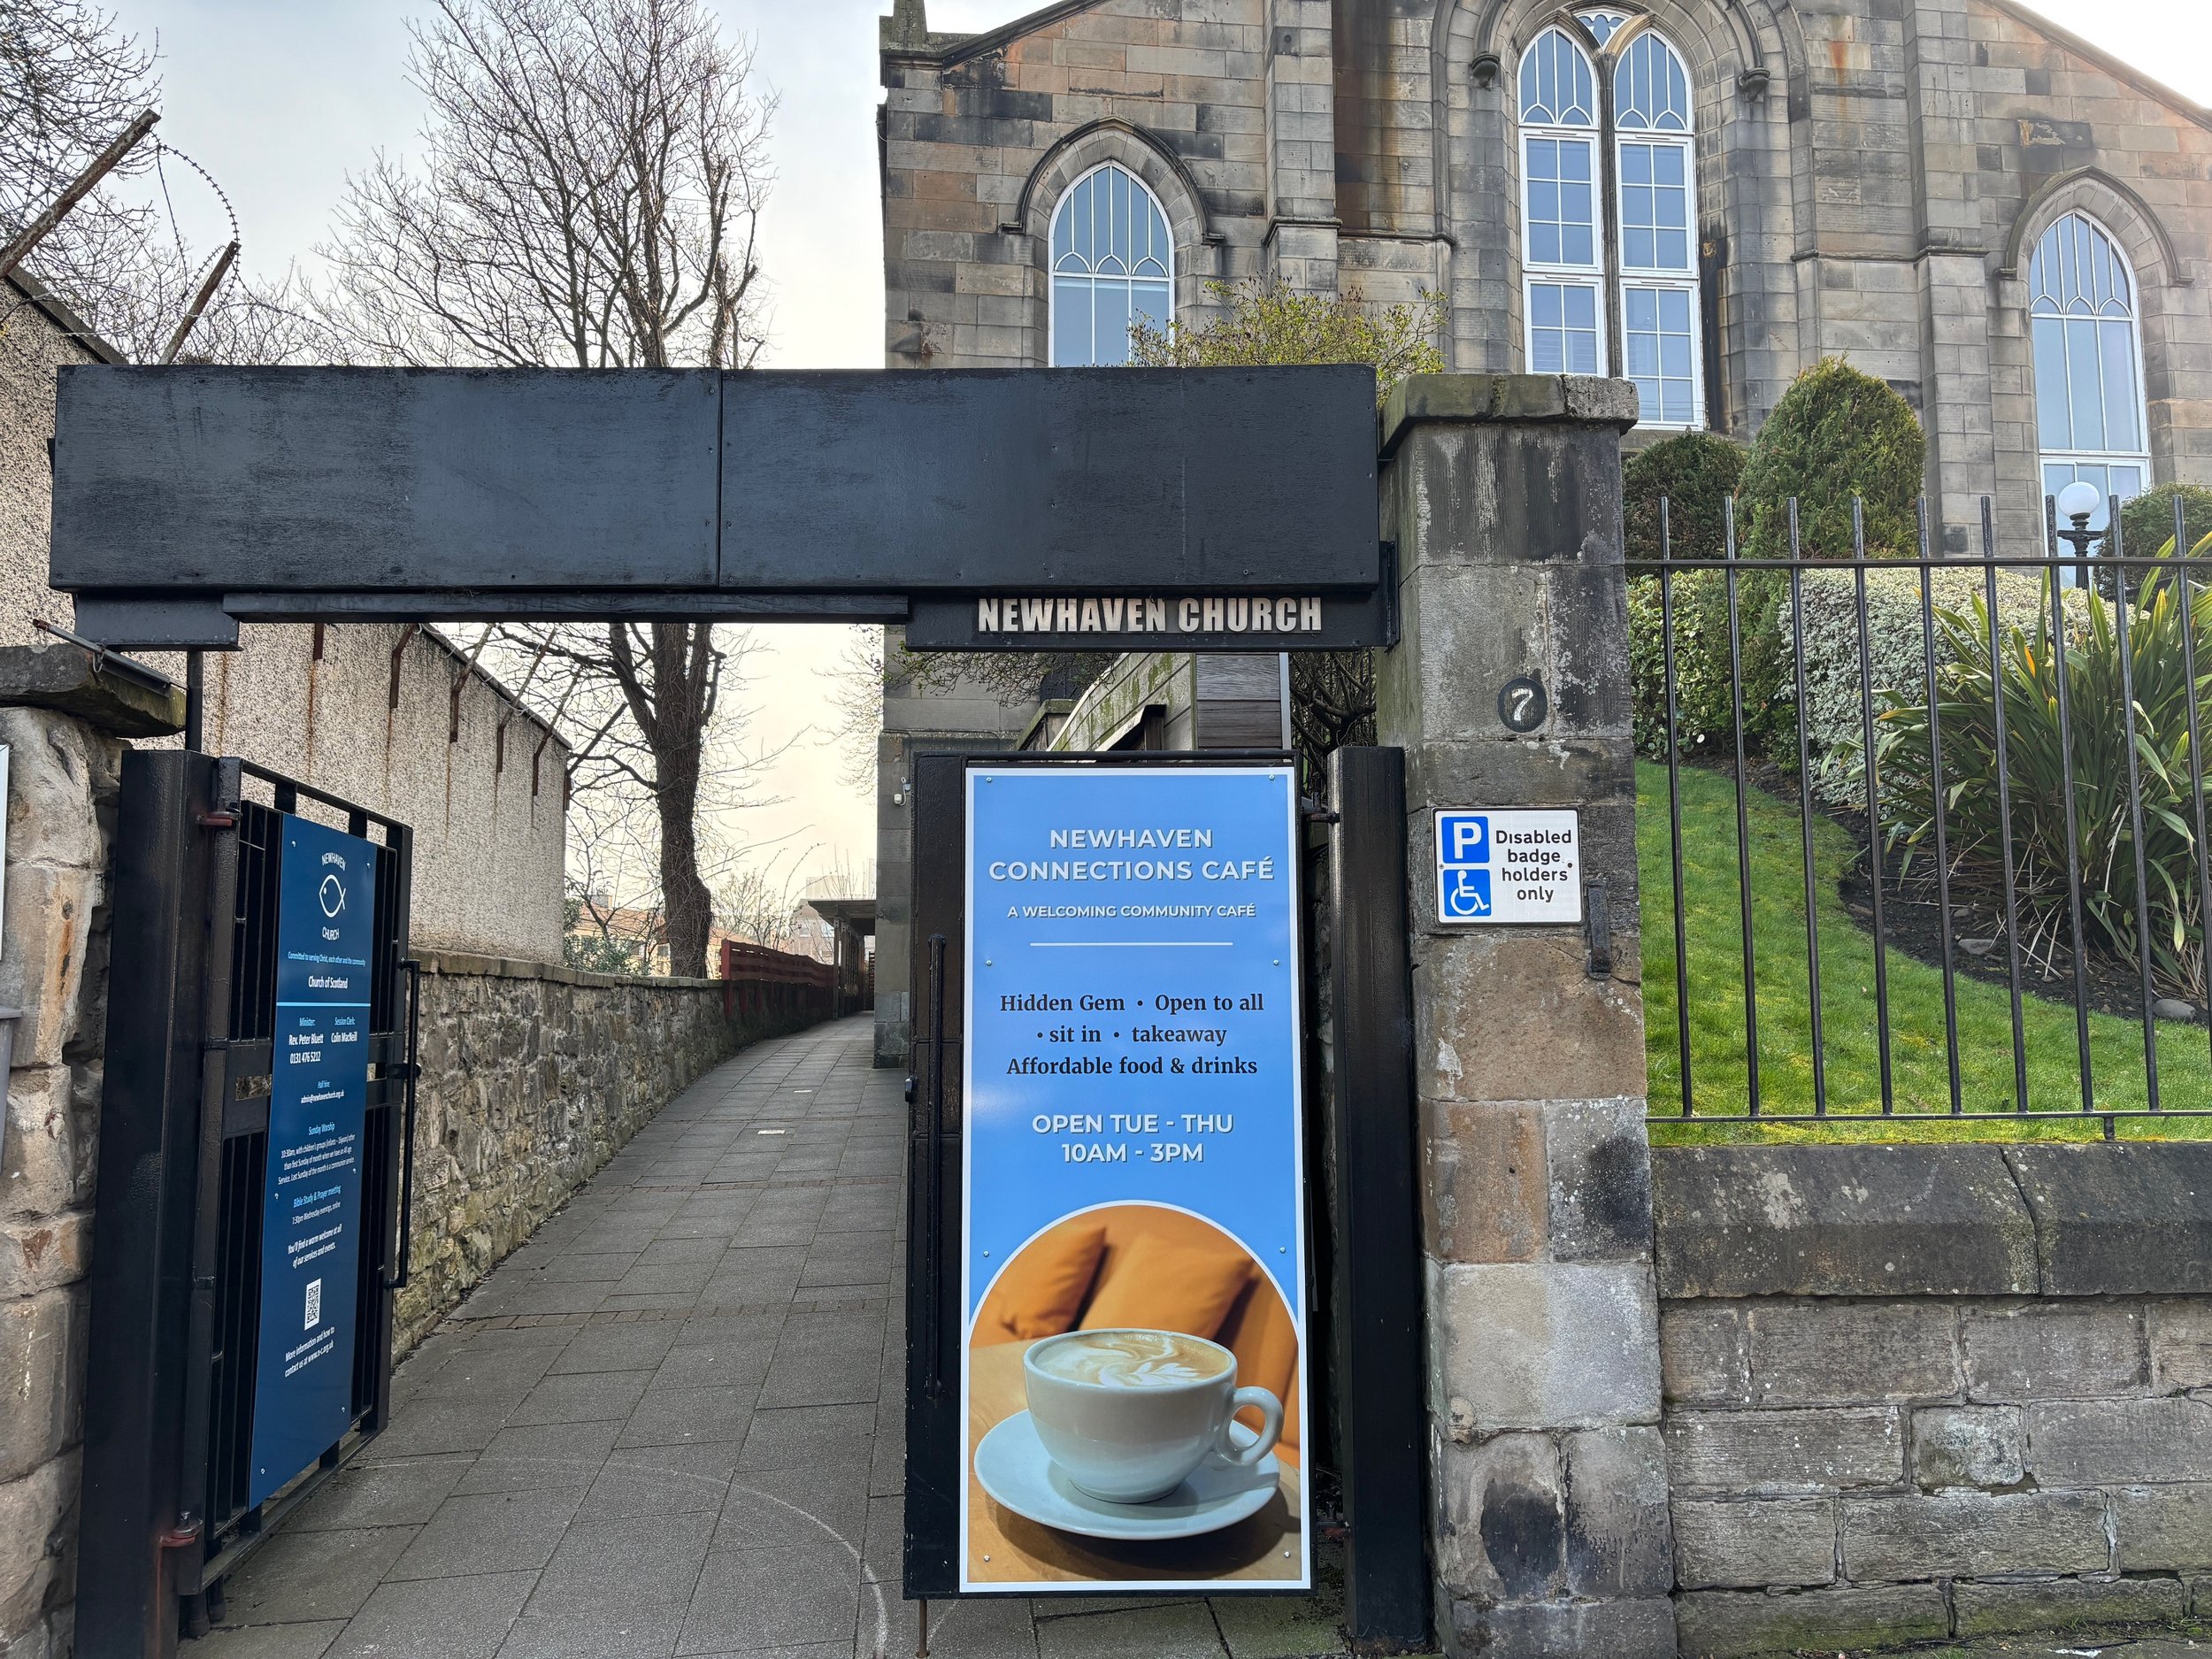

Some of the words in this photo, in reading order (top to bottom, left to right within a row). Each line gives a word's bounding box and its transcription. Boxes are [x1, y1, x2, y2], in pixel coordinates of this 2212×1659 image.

[978, 597, 1166, 633] NEWHAVEN
[1178, 597, 1322, 633] CHURCH
[1511, 687, 1534, 721] 7
[1049, 829, 1213, 849] NEWHAVEN
[1454, 822, 1481, 859] P
[1495, 830, 1572, 844] Disabled
[321, 852, 346, 872] NEWHAVEN
[1508, 848, 1561, 864] badge
[988, 861, 1193, 881] CONNECTIONS
[1202, 856, 1274, 880] CAFÉ
[1502, 867, 1568, 881] holders
[1517, 887, 1554, 902] only
[1007, 906, 1018, 918] A
[1022, 906, 1118, 918] WELCOMING
[1120, 905, 1213, 918] COMMUNITY
[1217, 903, 1256, 917] CAFÉ
[322, 926, 340, 941] CHURCH
[309, 953, 319, 963] serving
[308, 975, 324, 987] Church
[325, 976, 330, 988] of
[330, 977, 348, 989] Scotland
[1000, 994, 1073, 1011] Hidden
[1079, 995, 1125, 1011] Gem
[1155, 995, 1206, 1015] Open
[1214, 996, 1233, 1011] to
[1239, 993, 1263, 1010] all
[299, 1017, 315, 1026] Minister:
[334, 1017, 346, 1025] Session
[288, 1034, 298, 1045] Rev.
[299, 1034, 311, 1045] Peter
[311, 1033, 324, 1044] Bluett
[331, 1032, 341, 1042] Colin
[342, 1031, 357, 1041] MacNeill
[1049, 1025, 1075, 1042] sit
[1081, 1025, 1102, 1042] in
[1132, 1025, 1227, 1046] takeaway
[290, 1053, 301, 1064] 0131
[311, 1051, 320, 1062] 5212
[1007, 1056, 1113, 1075] Affordable
[1118, 1056, 1163, 1075] food
[1170, 1057, 1185, 1074] &
[1191, 1056, 1258, 1074] drinks
[308, 1125, 321, 1135] Sunday
[321, 1121, 335, 1133] Worship
[1032, 1114, 1103, 1134] OPEN
[1110, 1114, 1159, 1133] TUE
[1181, 1114, 1234, 1133] THU
[1061, 1143, 1127, 1163] 10AM
[1150, 1142, 1204, 1163] 3PM
[298, 1157, 309, 1166] Sunday
[297, 1170, 308, 1179] Sunday
[294, 1196, 303, 1208] Bible
[303, 1194, 313, 1204] Study
[318, 1190, 327, 1200] Prayer
[328, 1185, 342, 1195] meeting
[303, 1208, 319, 1220] Wednesday
[288, 1241, 298, 1255] You'll
[297, 1239, 306, 1252] find
[309, 1235, 319, 1246] warm
[319, 1230, 334, 1241] welcome
[293, 1256, 298, 1269] of
[303, 1249, 318, 1263] services
[285, 1350, 296, 1362] More
[296, 1338, 316, 1356] information
[285, 1362, 299, 1378] contact
[299, 1360, 303, 1369] us
[303, 1356, 308, 1365] at
